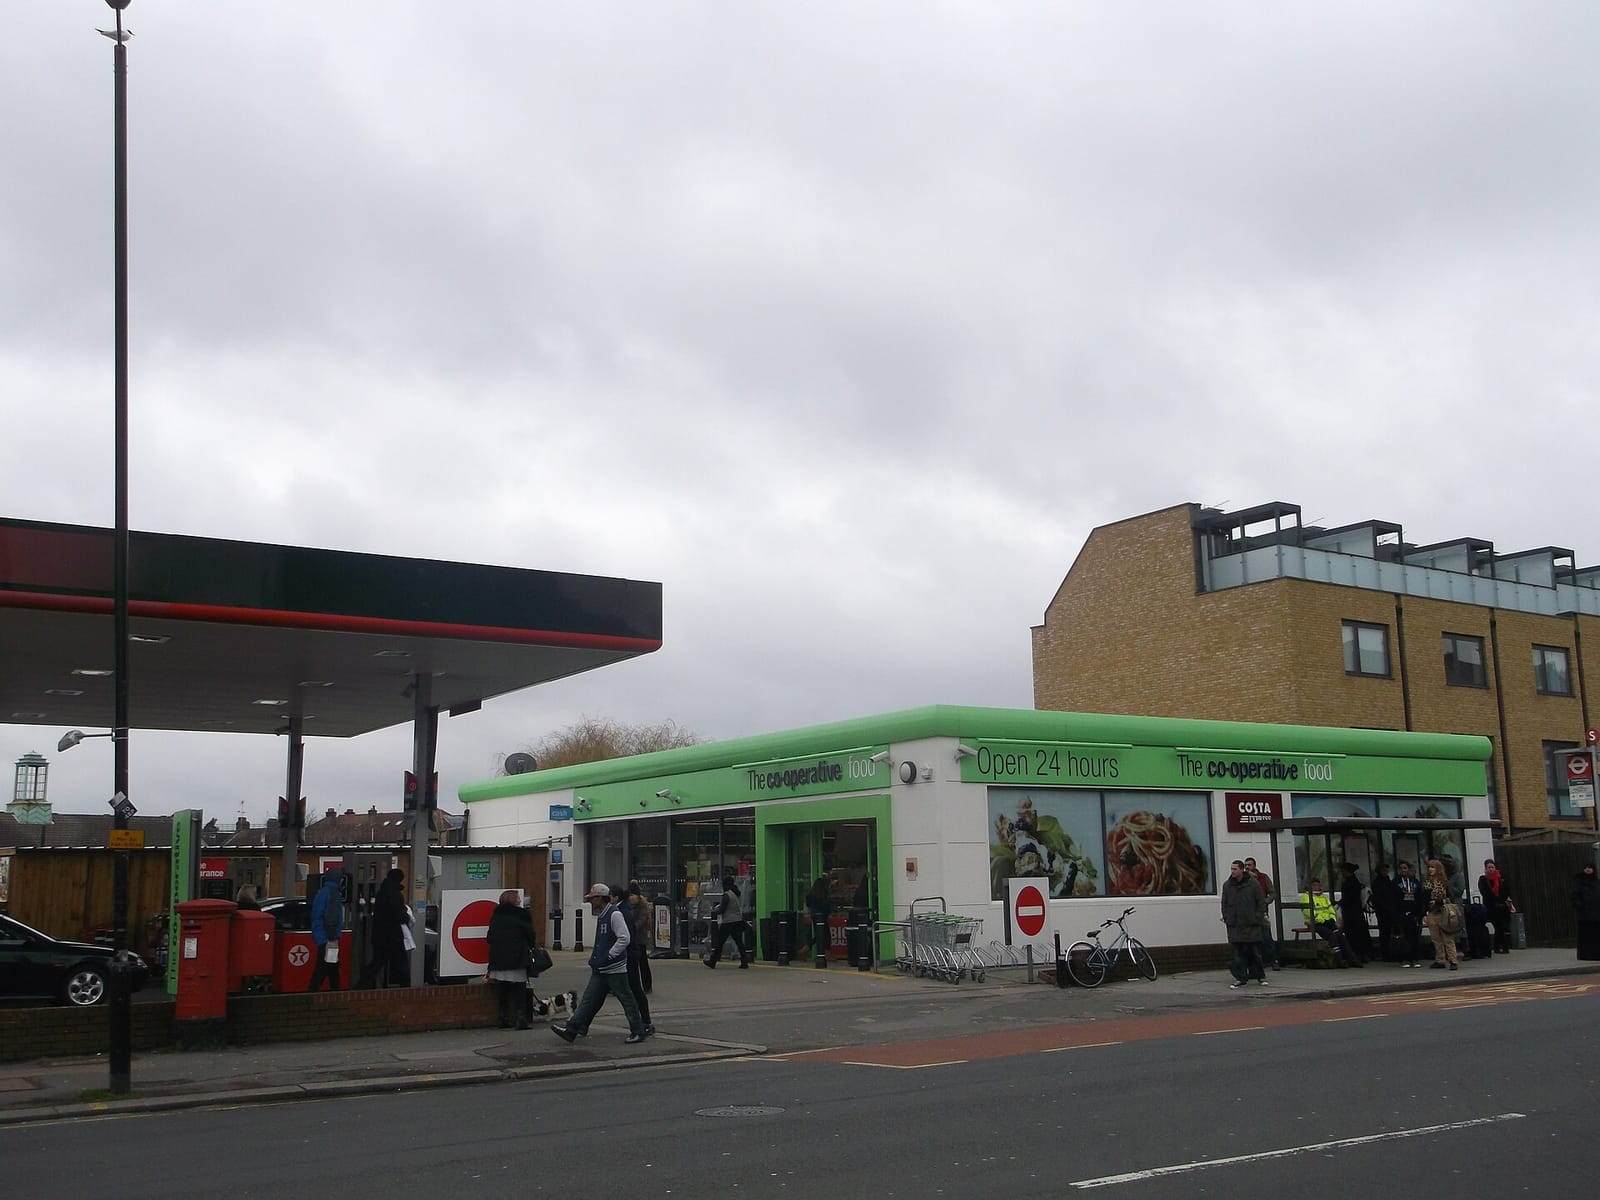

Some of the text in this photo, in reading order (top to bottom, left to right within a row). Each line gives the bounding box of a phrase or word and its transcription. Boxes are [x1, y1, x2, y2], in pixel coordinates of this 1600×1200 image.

[1588, 730, 1597, 741] S
[977, 746, 1119, 780] Open 24 hours
[1177, 754, 1333, 783] The co-operative food
[747, 754, 876, 791] The co-operative food
[551, 808, 568, 818] cash
[1238, 801, 1271, 815] COSTA
[600, 923, 607, 934] H
